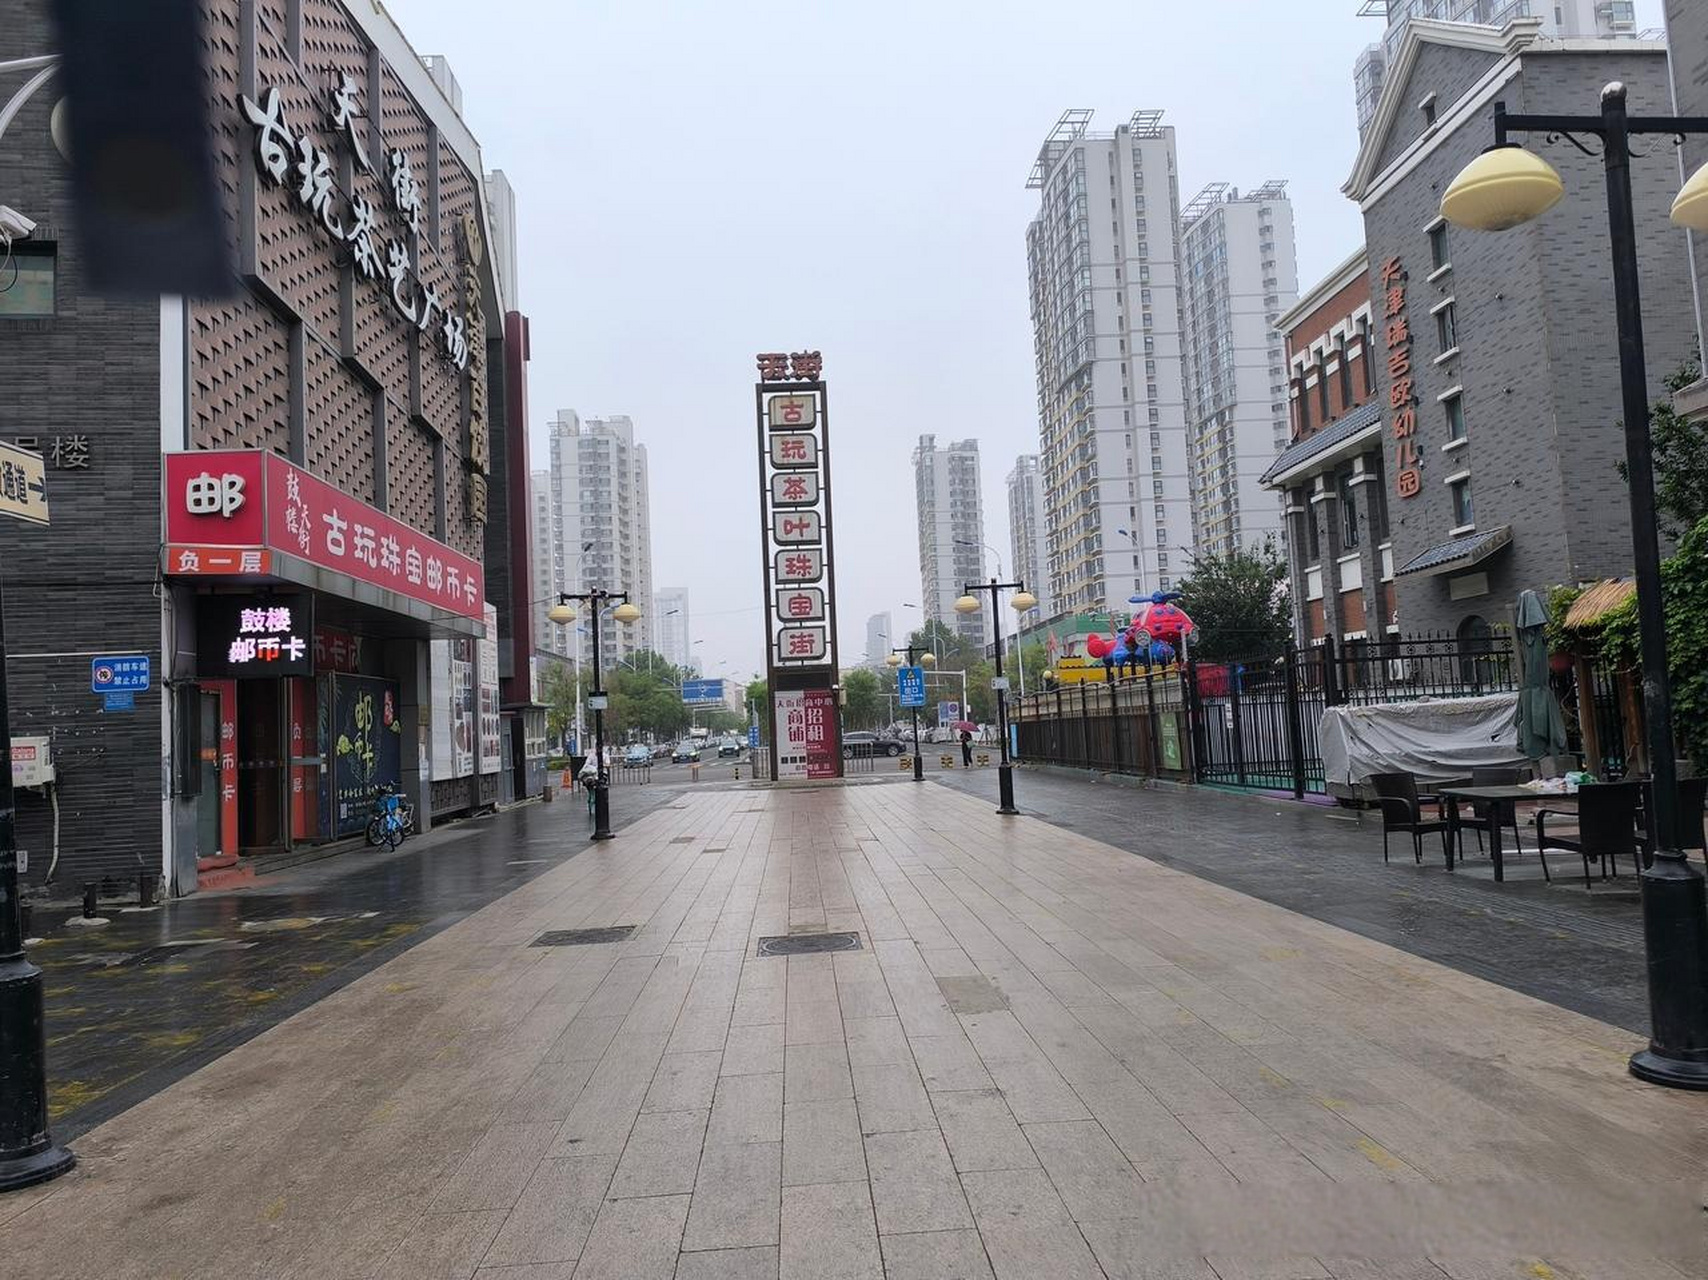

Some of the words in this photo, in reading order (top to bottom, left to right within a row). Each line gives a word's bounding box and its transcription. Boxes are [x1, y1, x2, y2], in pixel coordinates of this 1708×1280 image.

[187, 472, 246, 517] 邮
[780, 400, 815, 655] 古玩茶叶珠宝街
[178, 550, 262, 573] 负一层
[322, 507, 478, 608] 古玩珠宝邮币卡
[240, 607, 292, 633] 鼓楼
[228, 636, 306, 663] 邮币卡
[221, 721, 236, 802] 邮币卡
